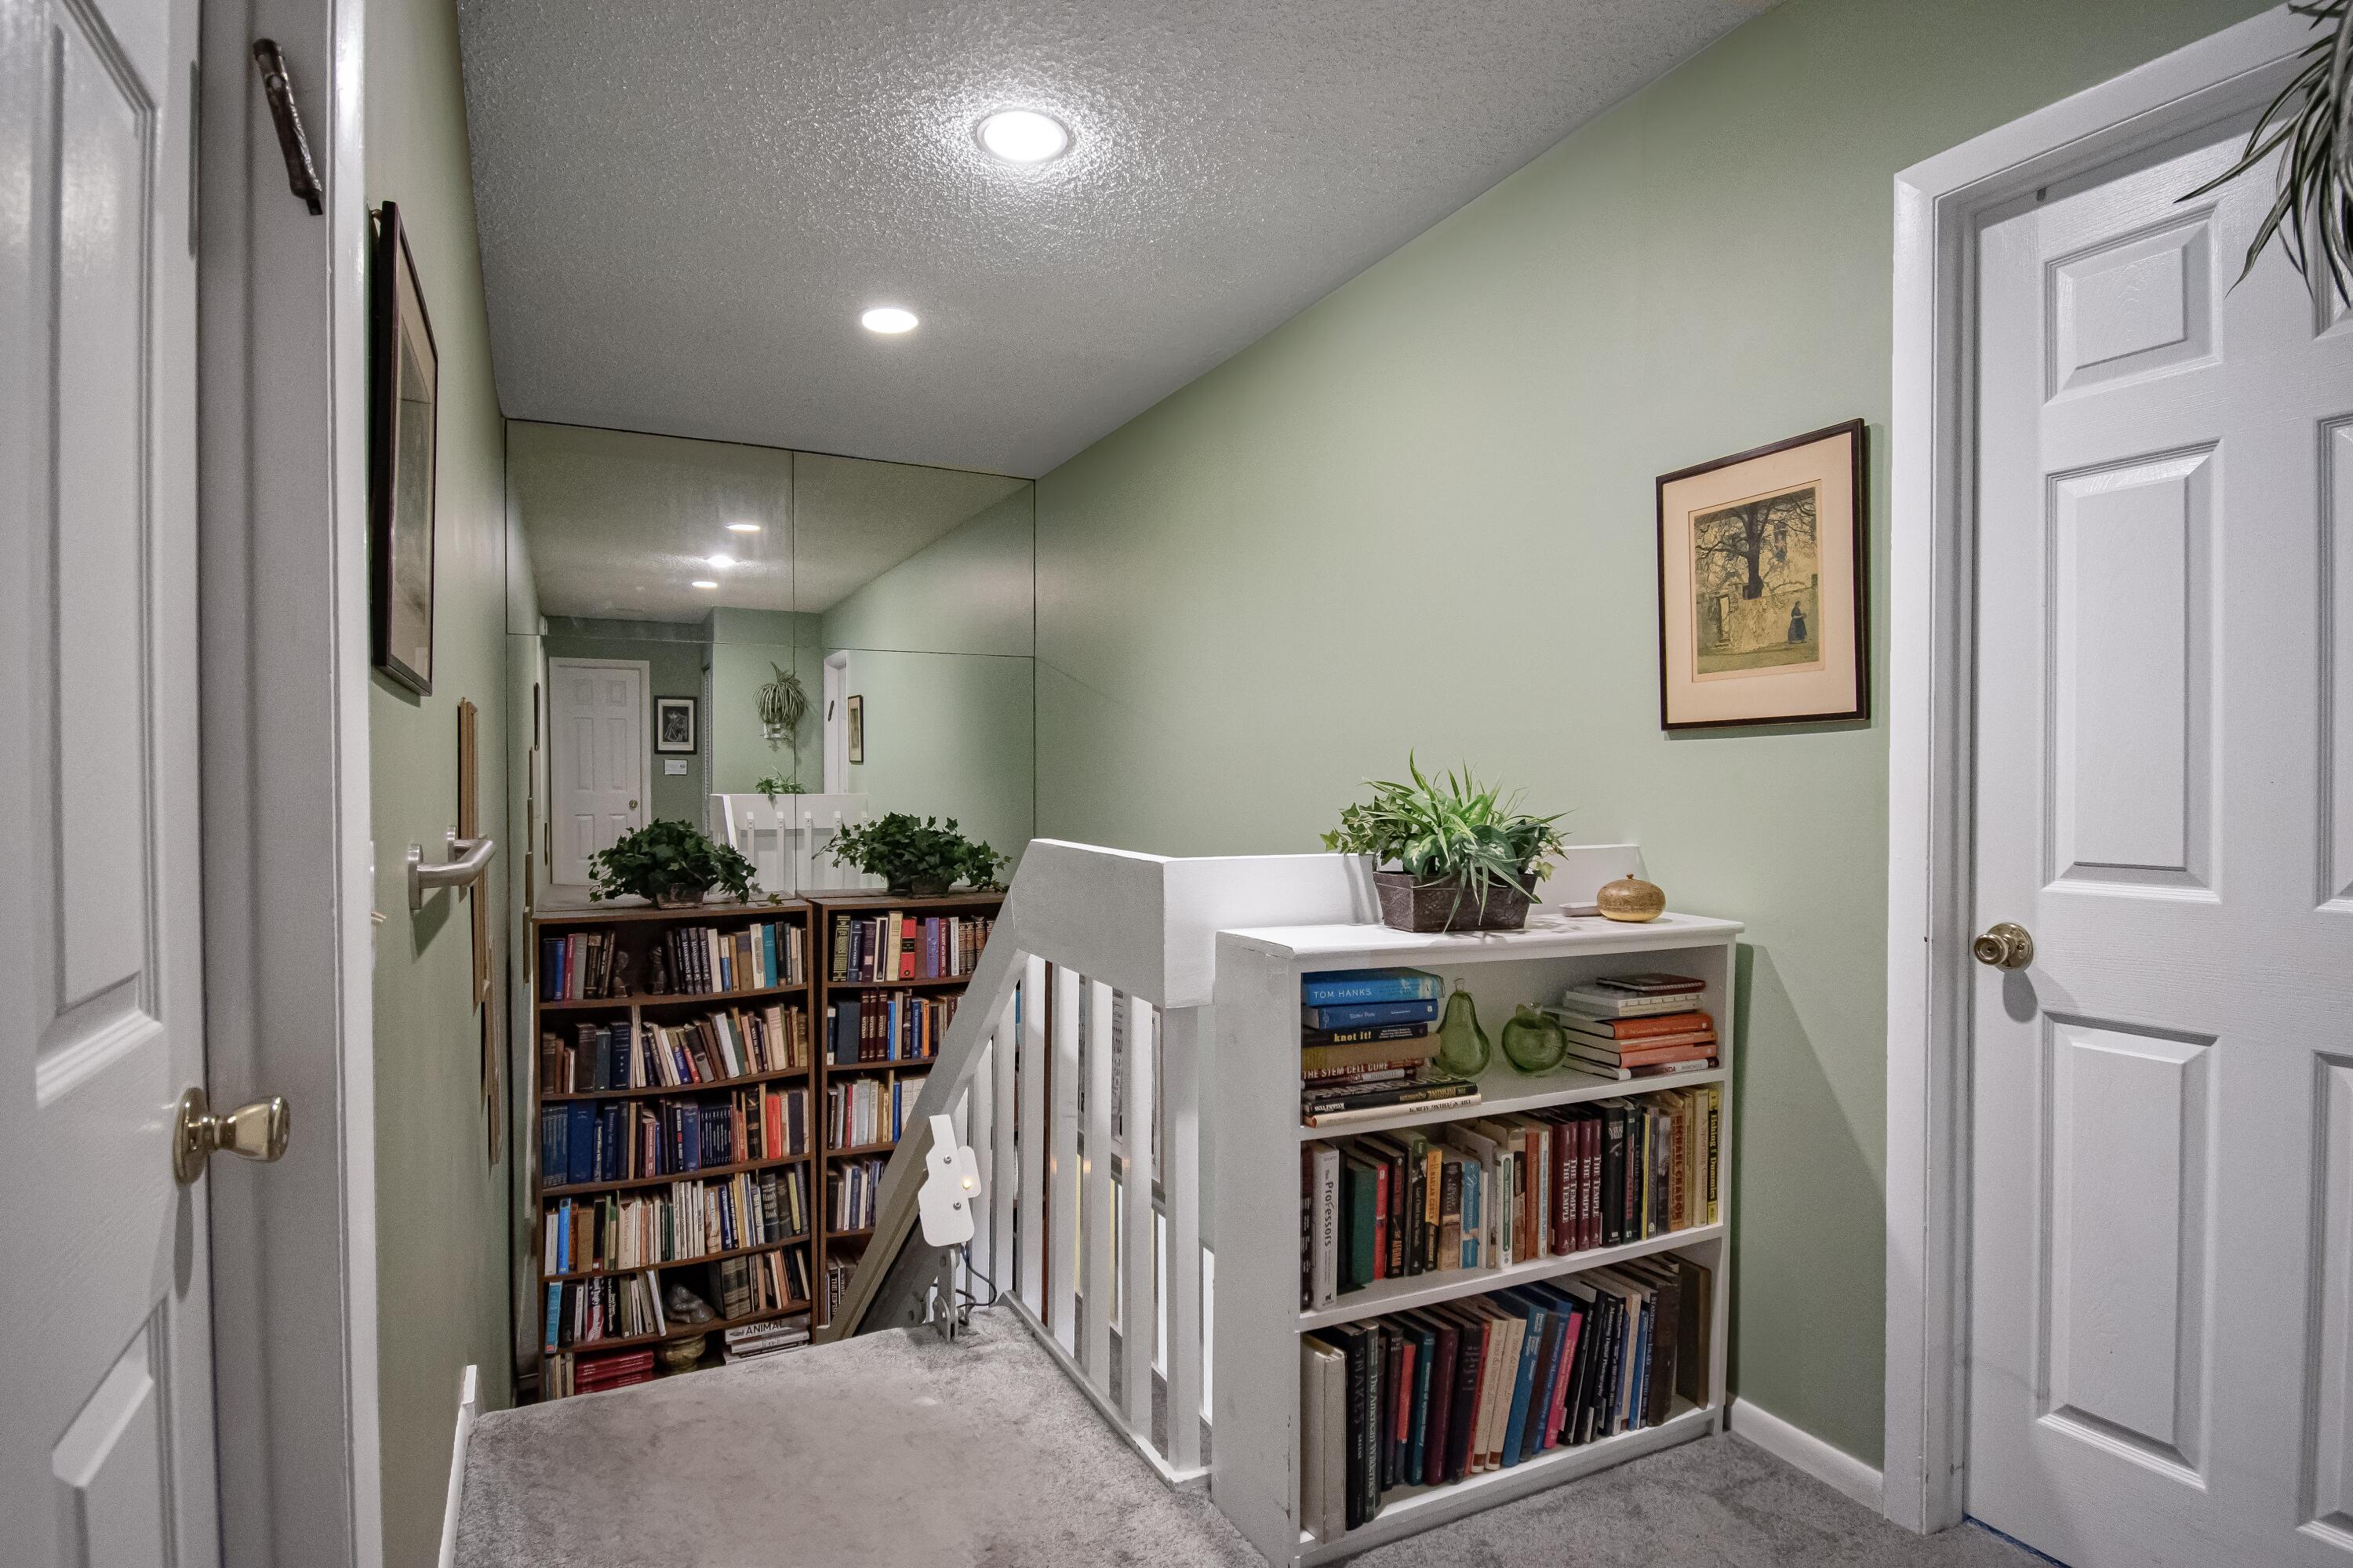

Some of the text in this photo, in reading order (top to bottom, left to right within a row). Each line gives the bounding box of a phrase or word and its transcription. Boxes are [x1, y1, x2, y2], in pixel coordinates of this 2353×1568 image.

[682, 941, 691, 973] MAIMONIDES
[690, 941, 699, 973] MAIMONIDES
[1314, 988, 1372, 999] TOM HANKS
[1334, 1032, 1357, 1042] knot
[1360, 1031, 1372, 1040] it!
[1304, 1069, 1318, 1080] THE
[1321, 1065, 1344, 1077] STEM
[1347, 1063, 1366, 1075] CELL
[1324, 1181, 1335, 1247] Professors
[1562, 1184, 1570, 1223] TEMPLE
[1582, 1180, 1591, 1221] TEMPLE
[1592, 1177, 1601, 1217] TEMPLE
[1391, 1240, 1402, 1267] AFGHAN
[746, 1319, 785, 1336] ANIMAL
[1606, 1305, 1616, 1337] Mastering
[1551, 1322, 1565, 1362] Elementary
[1354, 1346, 1365, 1424] SNAKES
[1597, 1359, 1607, 1397] Photography
[1367, 1373, 1378, 1497] The American Wilderness
